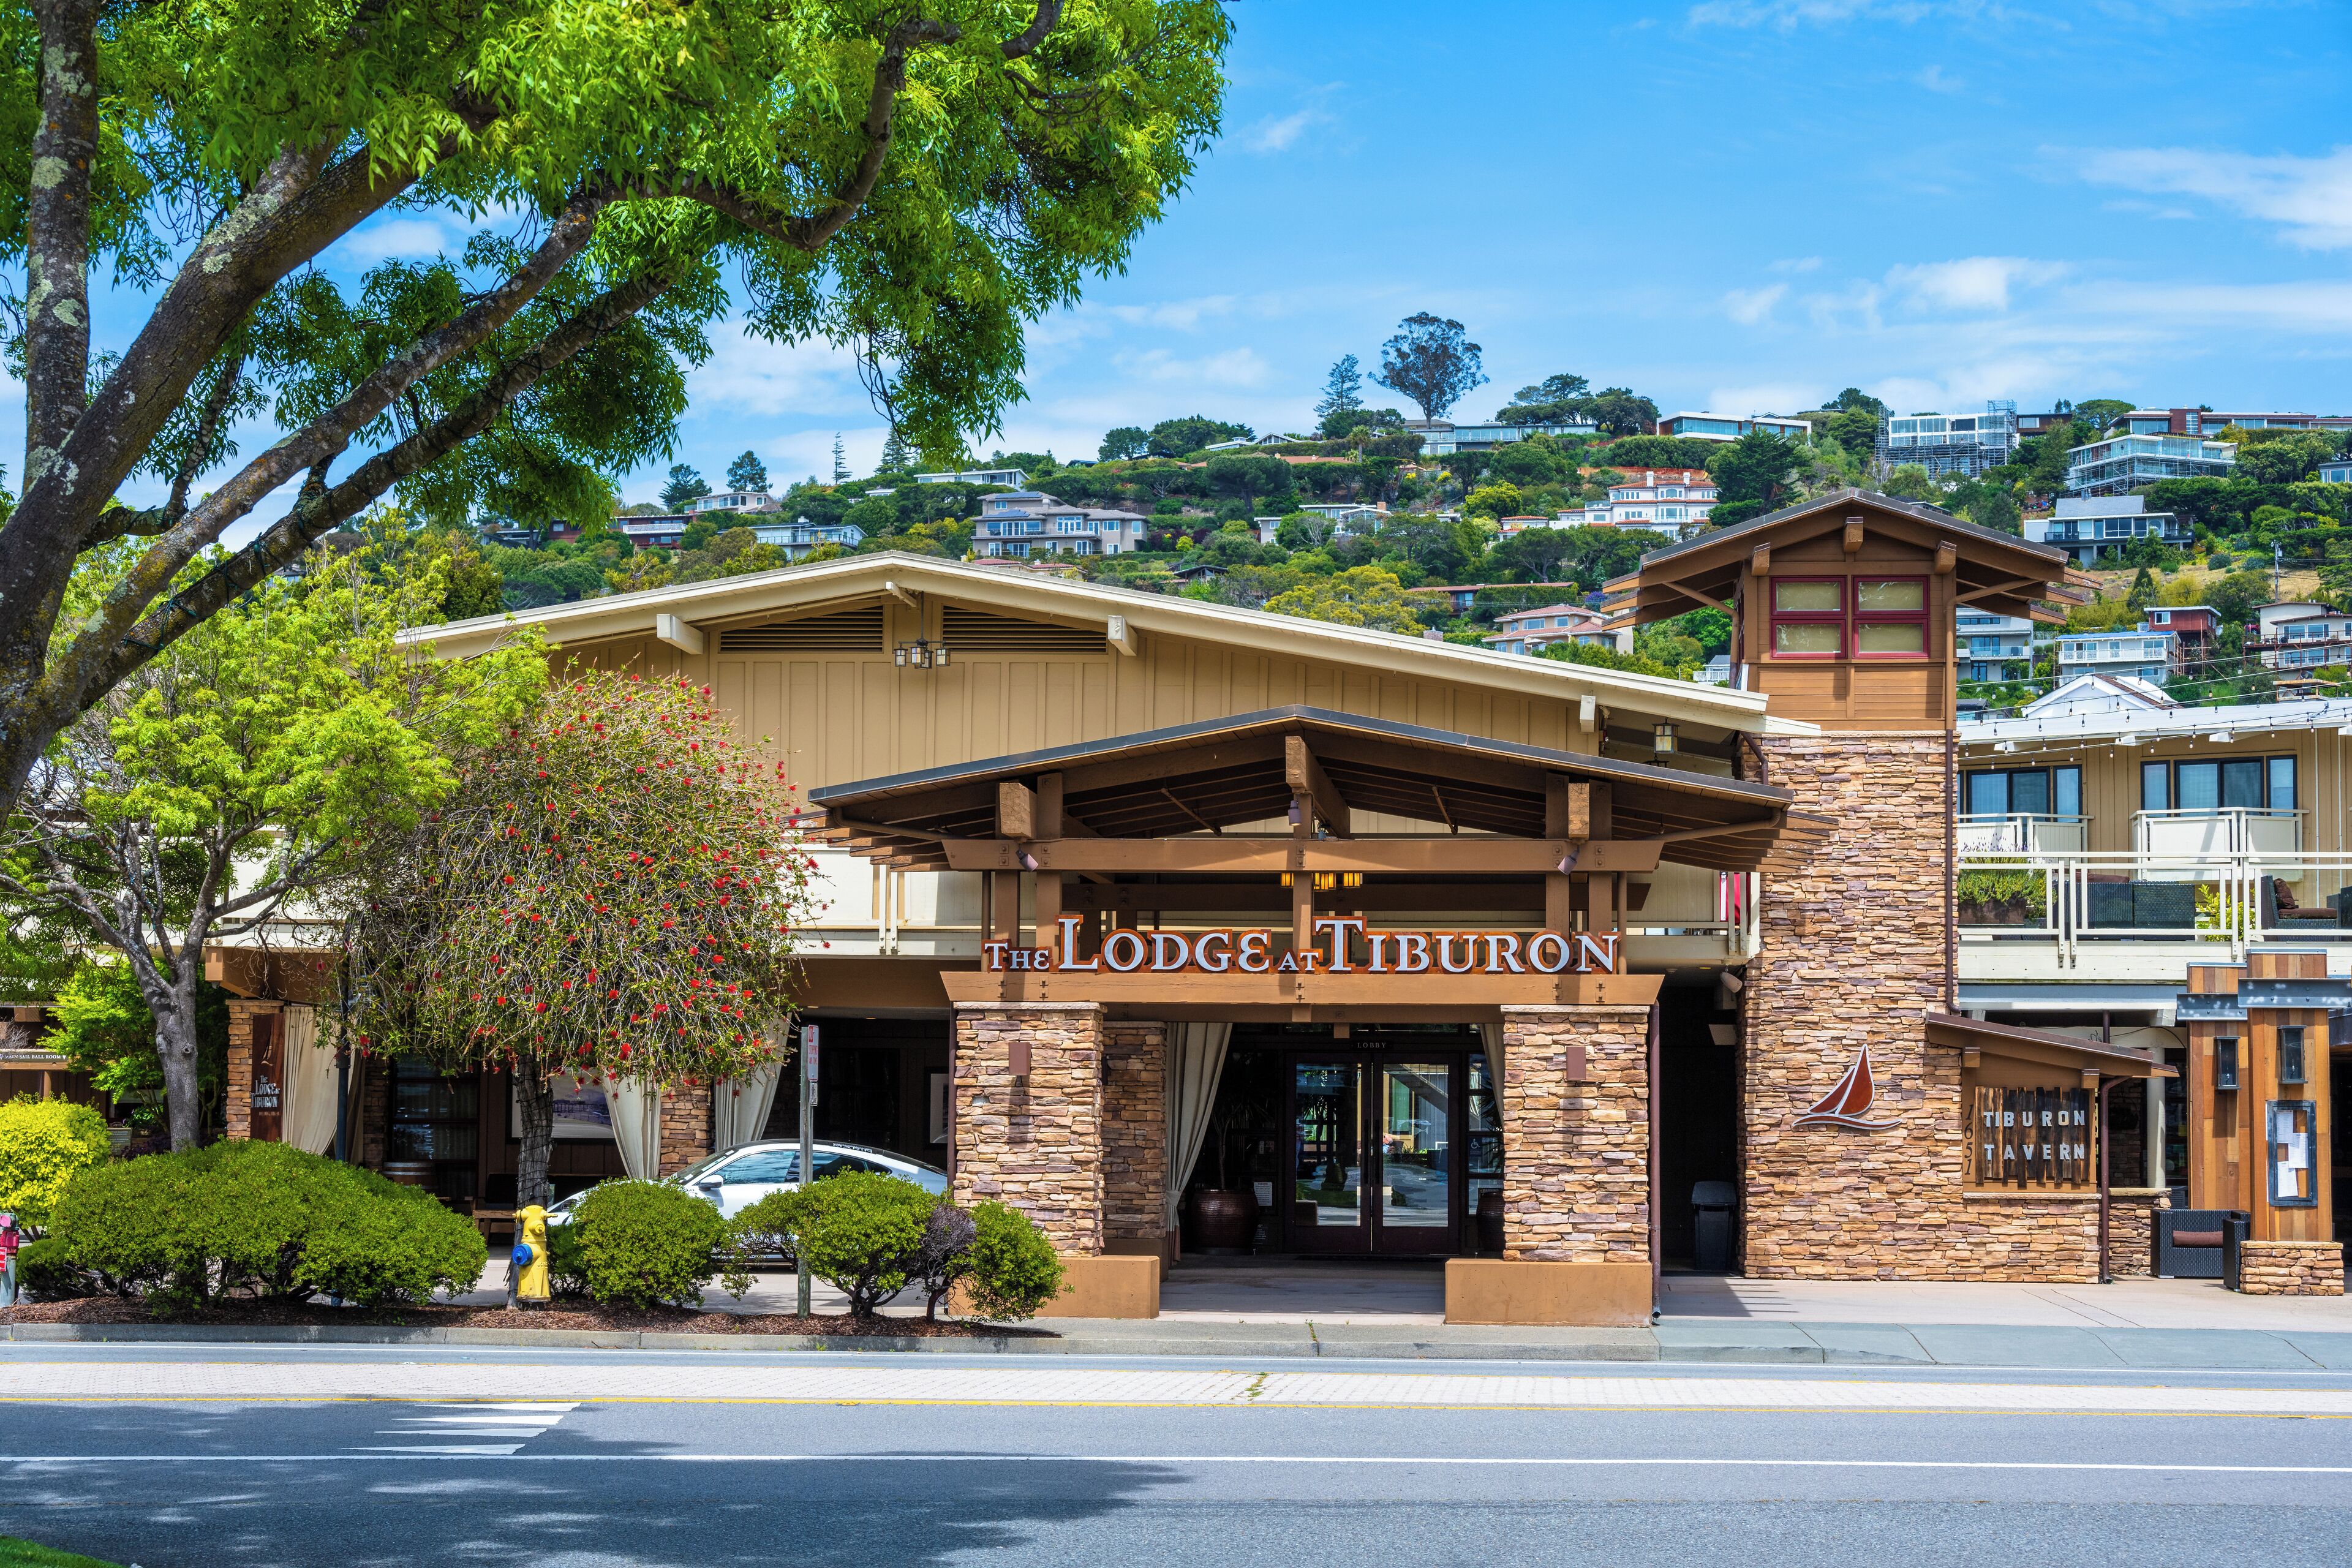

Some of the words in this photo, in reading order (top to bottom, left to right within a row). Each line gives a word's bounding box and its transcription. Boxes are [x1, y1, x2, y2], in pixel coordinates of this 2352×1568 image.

[984, 941, 1050, 970] THE
[1057, 917, 1270, 972] LODGE
[1278, 951, 1321, 972] AT
[1315, 919, 1619, 973] TIBURON
[255, 1080, 276, 1095] LODGE
[250, 1093, 278, 1107] TIBURON
[1983, 1110, 2086, 1128] TIBURON
[1964, 1104, 1974, 1175] 1651
[1983, 1144, 2085, 1161] TAVERN
